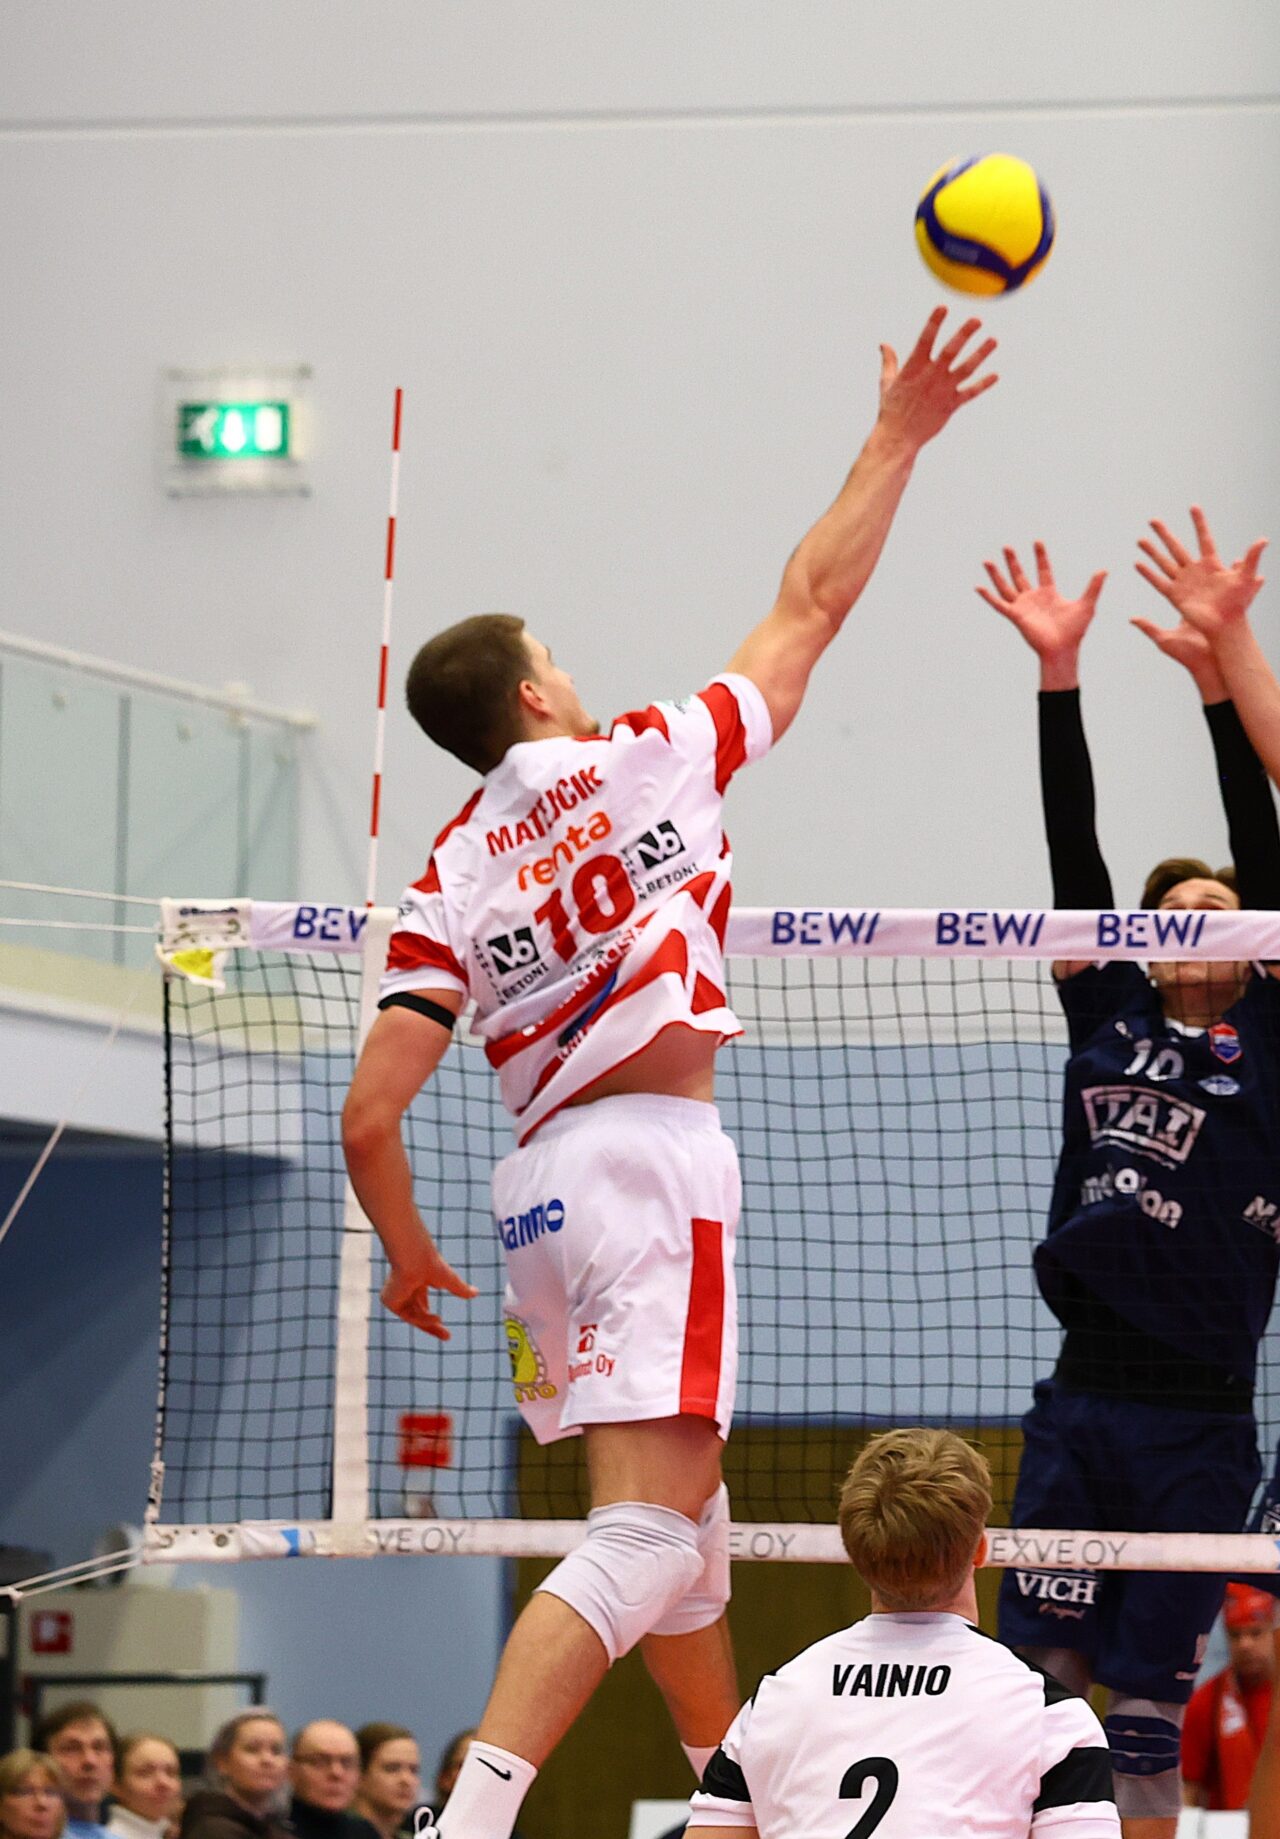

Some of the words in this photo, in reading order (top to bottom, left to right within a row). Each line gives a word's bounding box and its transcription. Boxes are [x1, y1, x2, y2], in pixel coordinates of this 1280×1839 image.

[517, 811, 612, 891] renta
[293, 906, 367, 941] BEW
[534, 854, 635, 963] 10
[1123, 1038, 1184, 1081] 10
[421, 1526, 466, 1553] OY
[750, 1532, 797, 1558] OY
[991, 1537, 1075, 1564] EXVE
[1082, 1539, 1128, 1566] OY
[832, 1663, 951, 1698] VAINIO
[838, 1756, 899, 1839] 2
